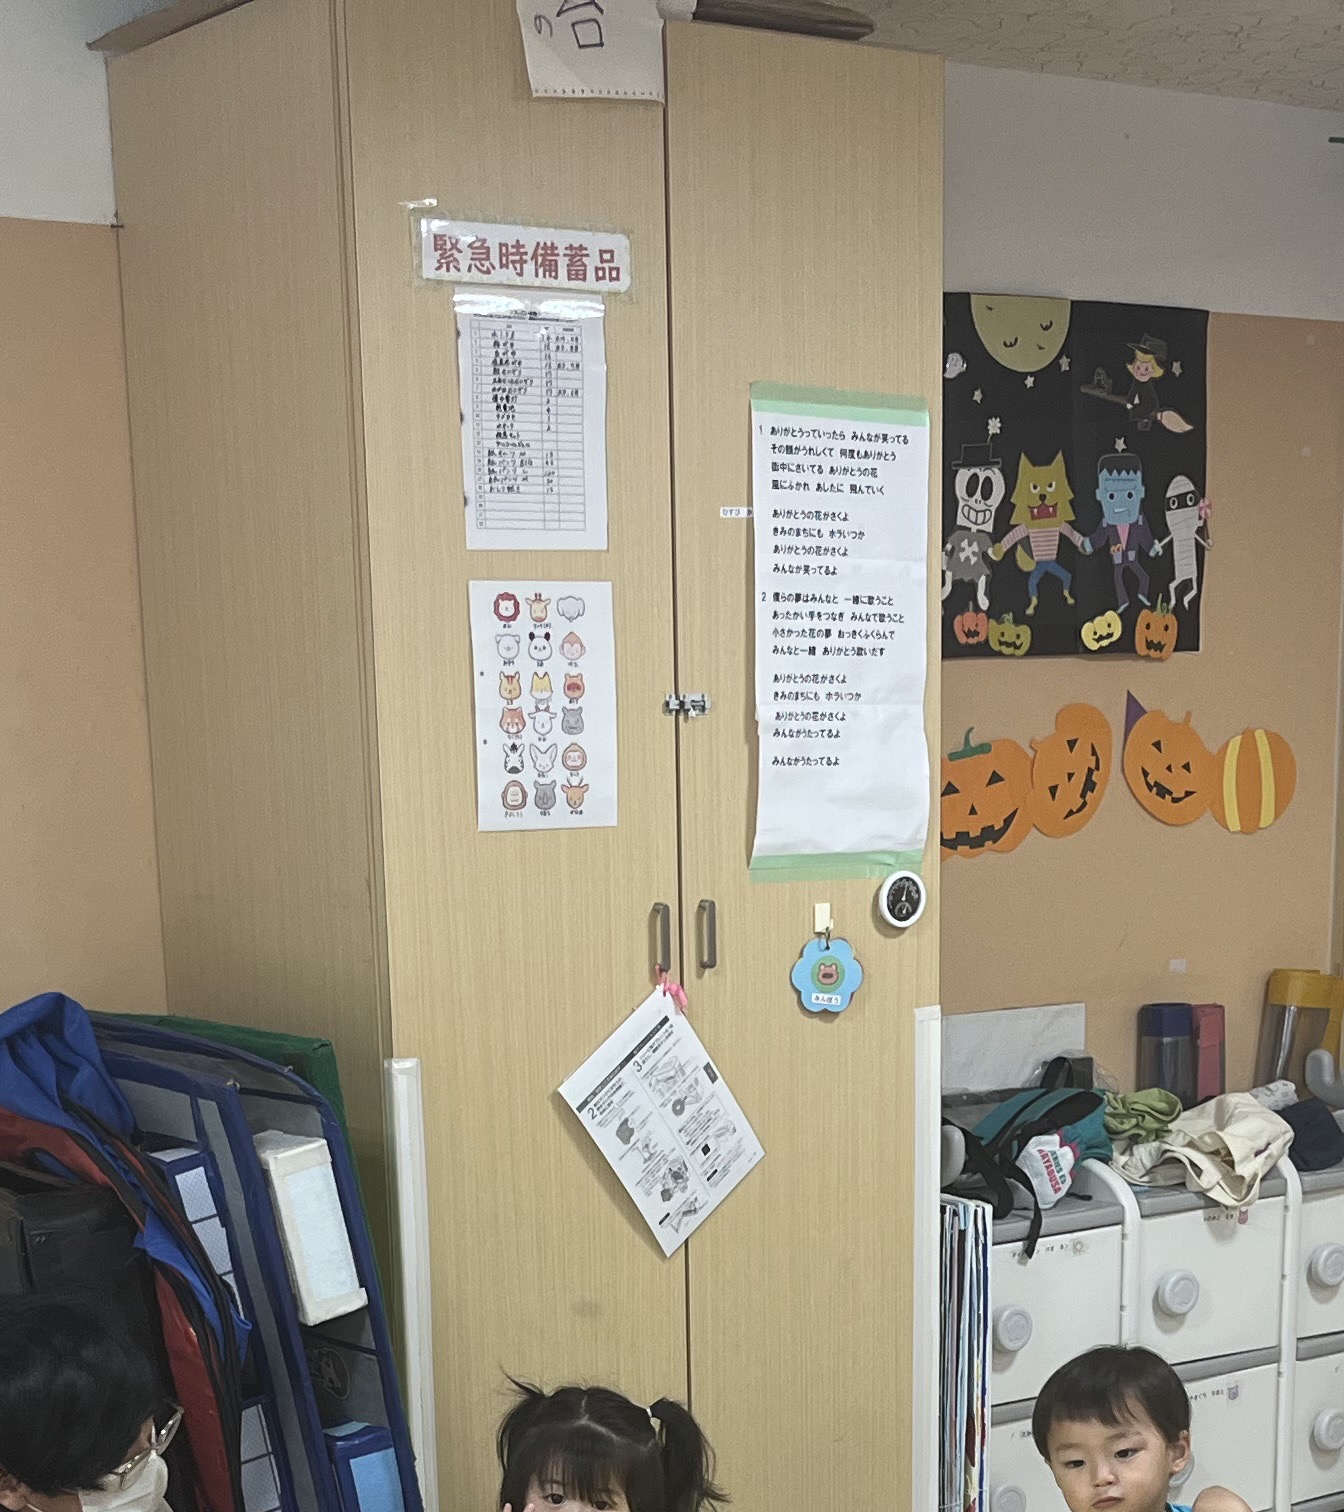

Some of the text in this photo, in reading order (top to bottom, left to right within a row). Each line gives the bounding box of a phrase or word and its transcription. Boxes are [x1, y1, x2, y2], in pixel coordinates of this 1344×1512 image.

[433, 232, 622, 284] 緊急時備蓄品
[770, 426, 845, 440] ありがとうっていったら
[829, 465, 878, 478] ありがとうの花
[816, 482, 844, 493] あしたに
[772, 509, 849, 521] ありがとうの花がさくよ
[773, 544, 848, 556] ありがとうの花がさくよ
[762, 592, 766, 602] 2
[773, 674, 847, 684] ありがとうの花がさくよ
[775, 711, 846, 721] ありがとうの花がさくよ
[632, 1060, 643, 1073] 3
[587, 1107, 598, 1120] 2
